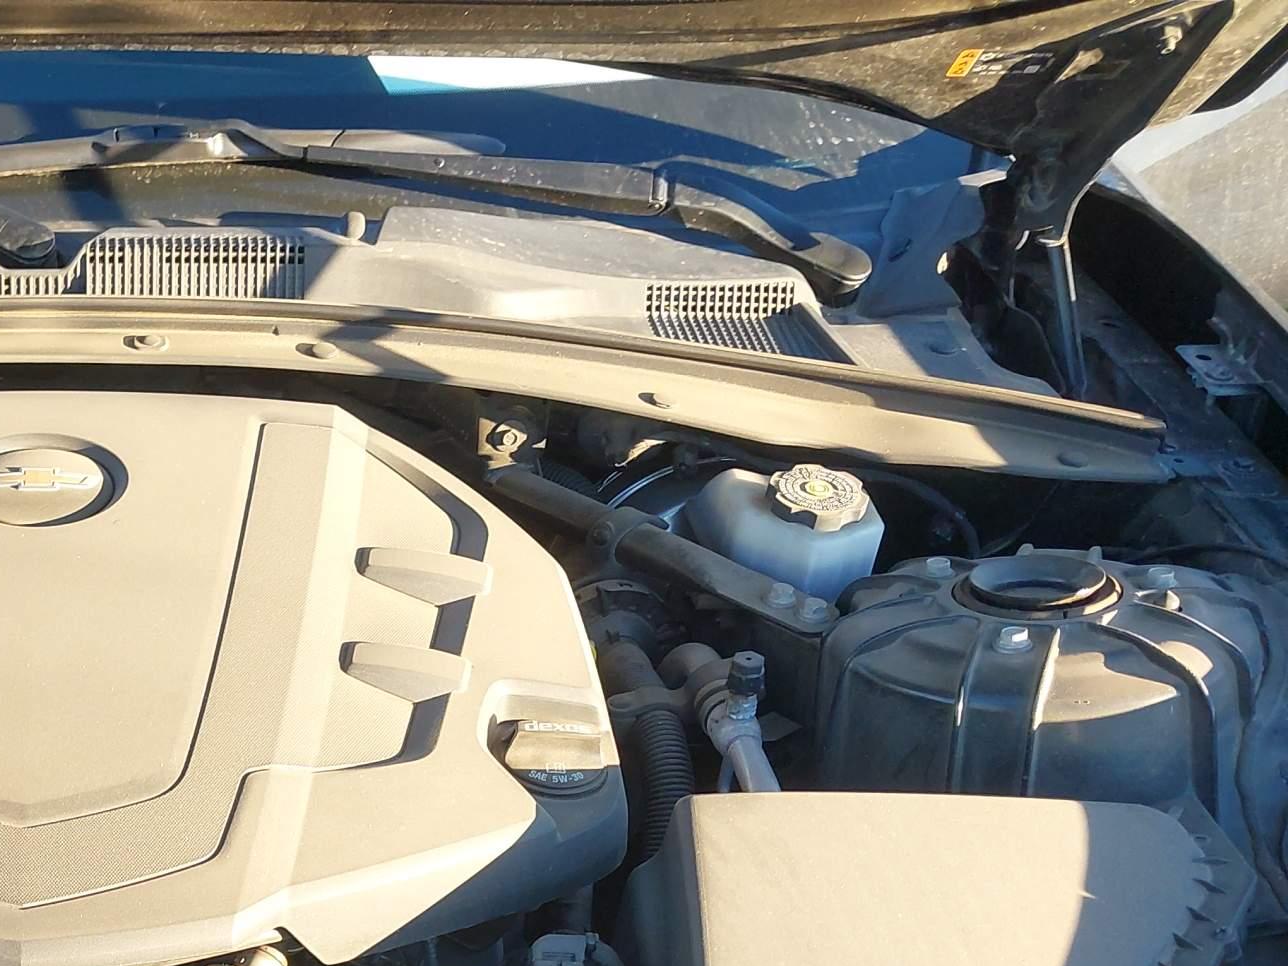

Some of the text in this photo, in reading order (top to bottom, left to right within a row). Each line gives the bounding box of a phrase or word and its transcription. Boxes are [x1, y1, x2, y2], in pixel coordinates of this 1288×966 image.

[524, 719, 593, 734] dexos
[528, 770, 584, 783] SAE 5W-30
